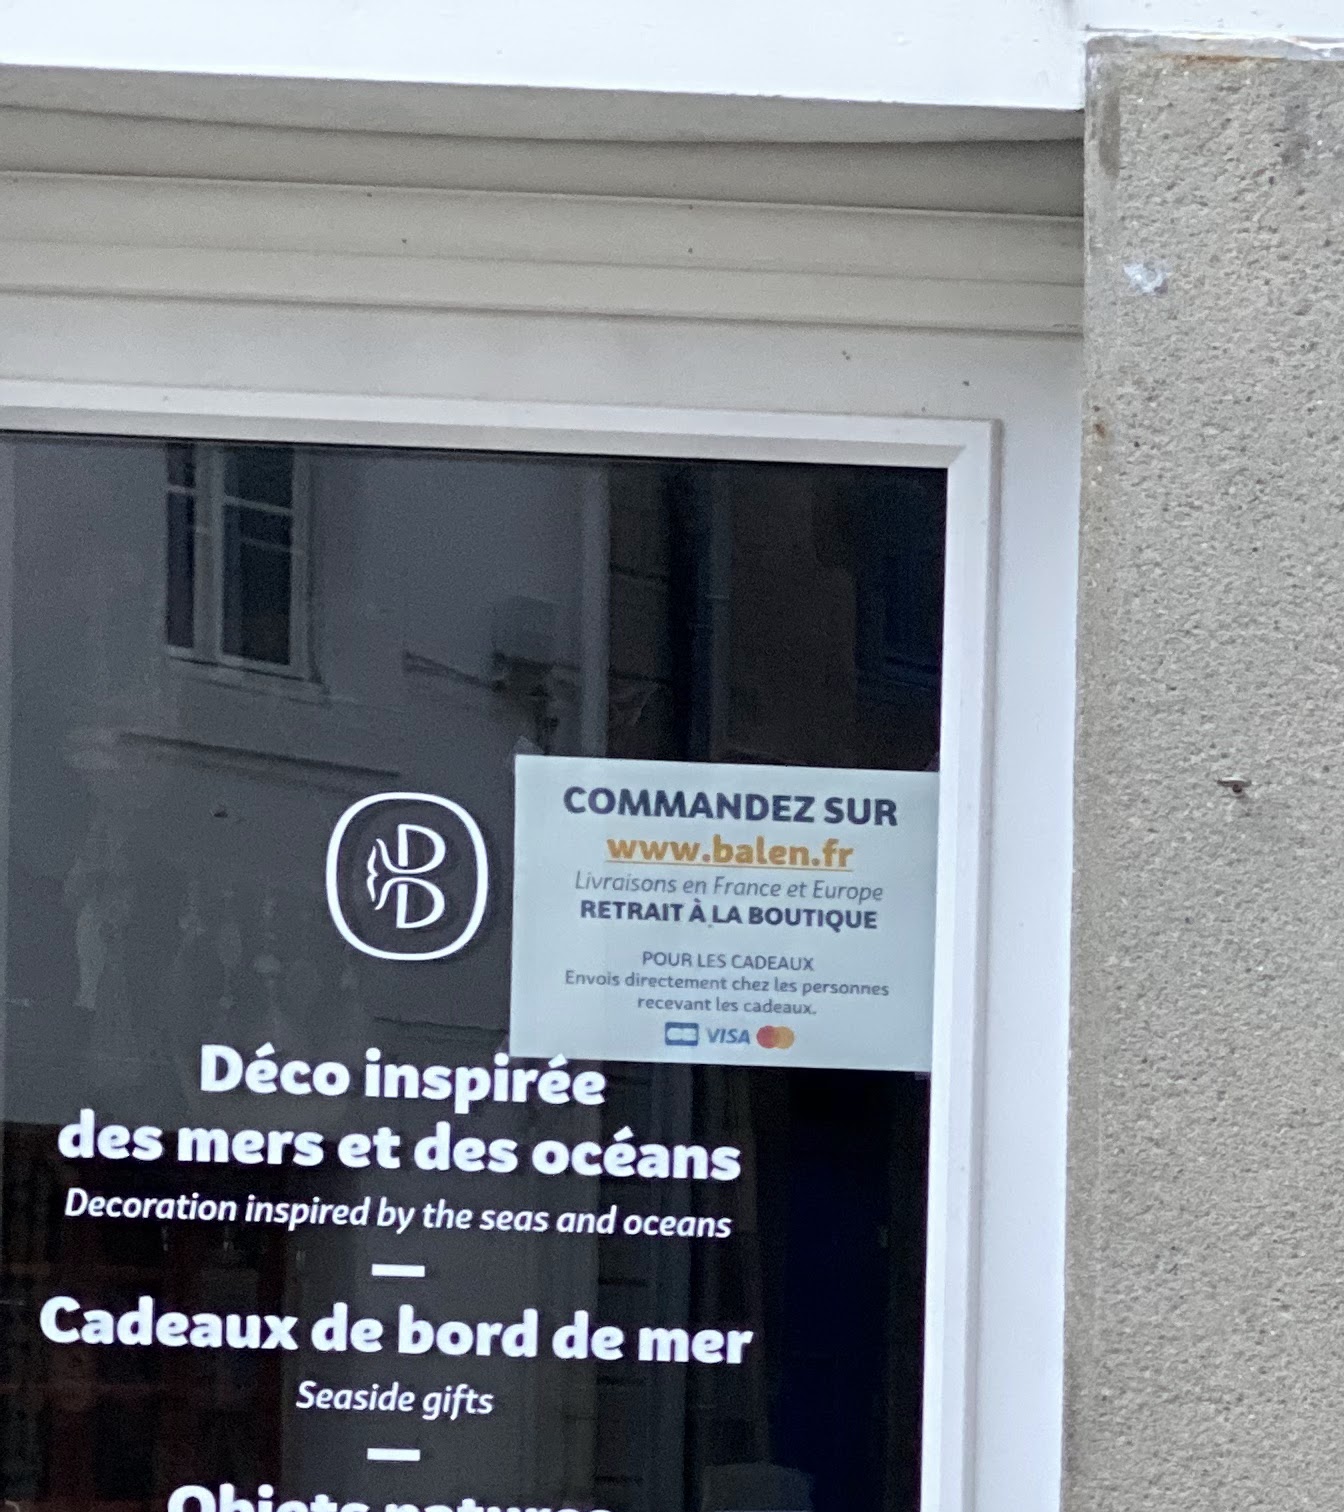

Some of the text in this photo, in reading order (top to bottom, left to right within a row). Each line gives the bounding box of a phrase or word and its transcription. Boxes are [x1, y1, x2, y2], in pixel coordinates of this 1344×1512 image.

[563, 785, 899, 828] COMMANDEZ SUR
[606, 834, 855, 869] www.balen.fr
[574, 871, 884, 902] Livraisons en France et Europe
[580, 894, 878, 933] RETRAIT À LA BOUTIQUE
[200, 1042, 607, 1114] Déco inspirée
[57, 1107, 742, 1182] des mers et des océans
[64, 1189, 732, 1239] Decoration inspired by the seas and oceans
[39, 1297, 753, 1365] Cadeaux de bord de mer
[295, 1379, 494, 1421] Seaside gifts
